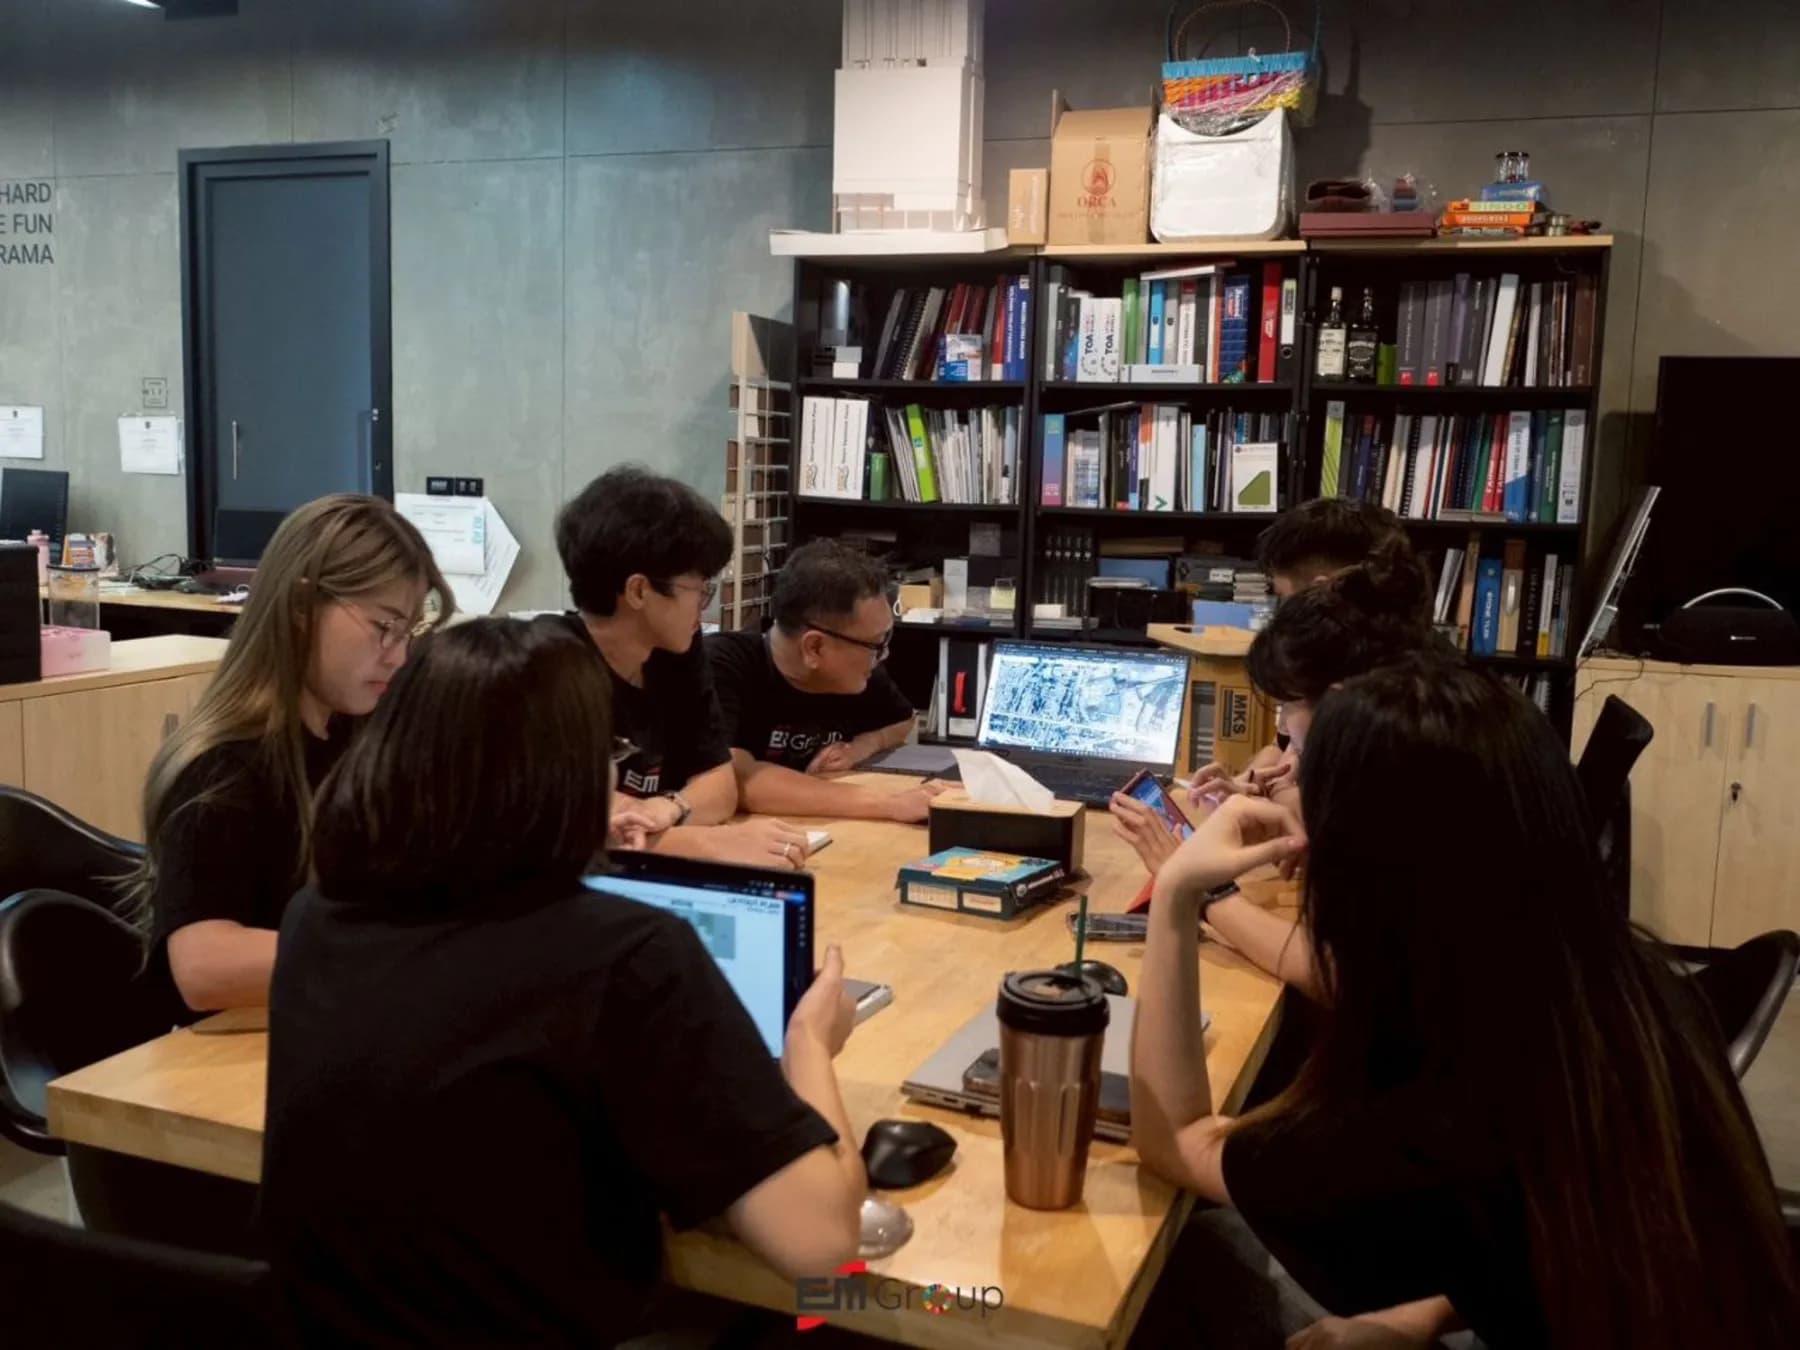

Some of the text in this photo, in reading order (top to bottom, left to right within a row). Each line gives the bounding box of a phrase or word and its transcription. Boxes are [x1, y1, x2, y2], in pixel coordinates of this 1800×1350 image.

[0, 183, 52, 204] HARD
[1077, 196, 1117, 208] ORCA
[13, 213, 52, 234] FUN
[1085, 333, 1094, 356] TOA
[1105, 333, 1114, 356] TOA
[1233, 694, 1247, 735] MKS
[624, 769, 660, 792] EM
